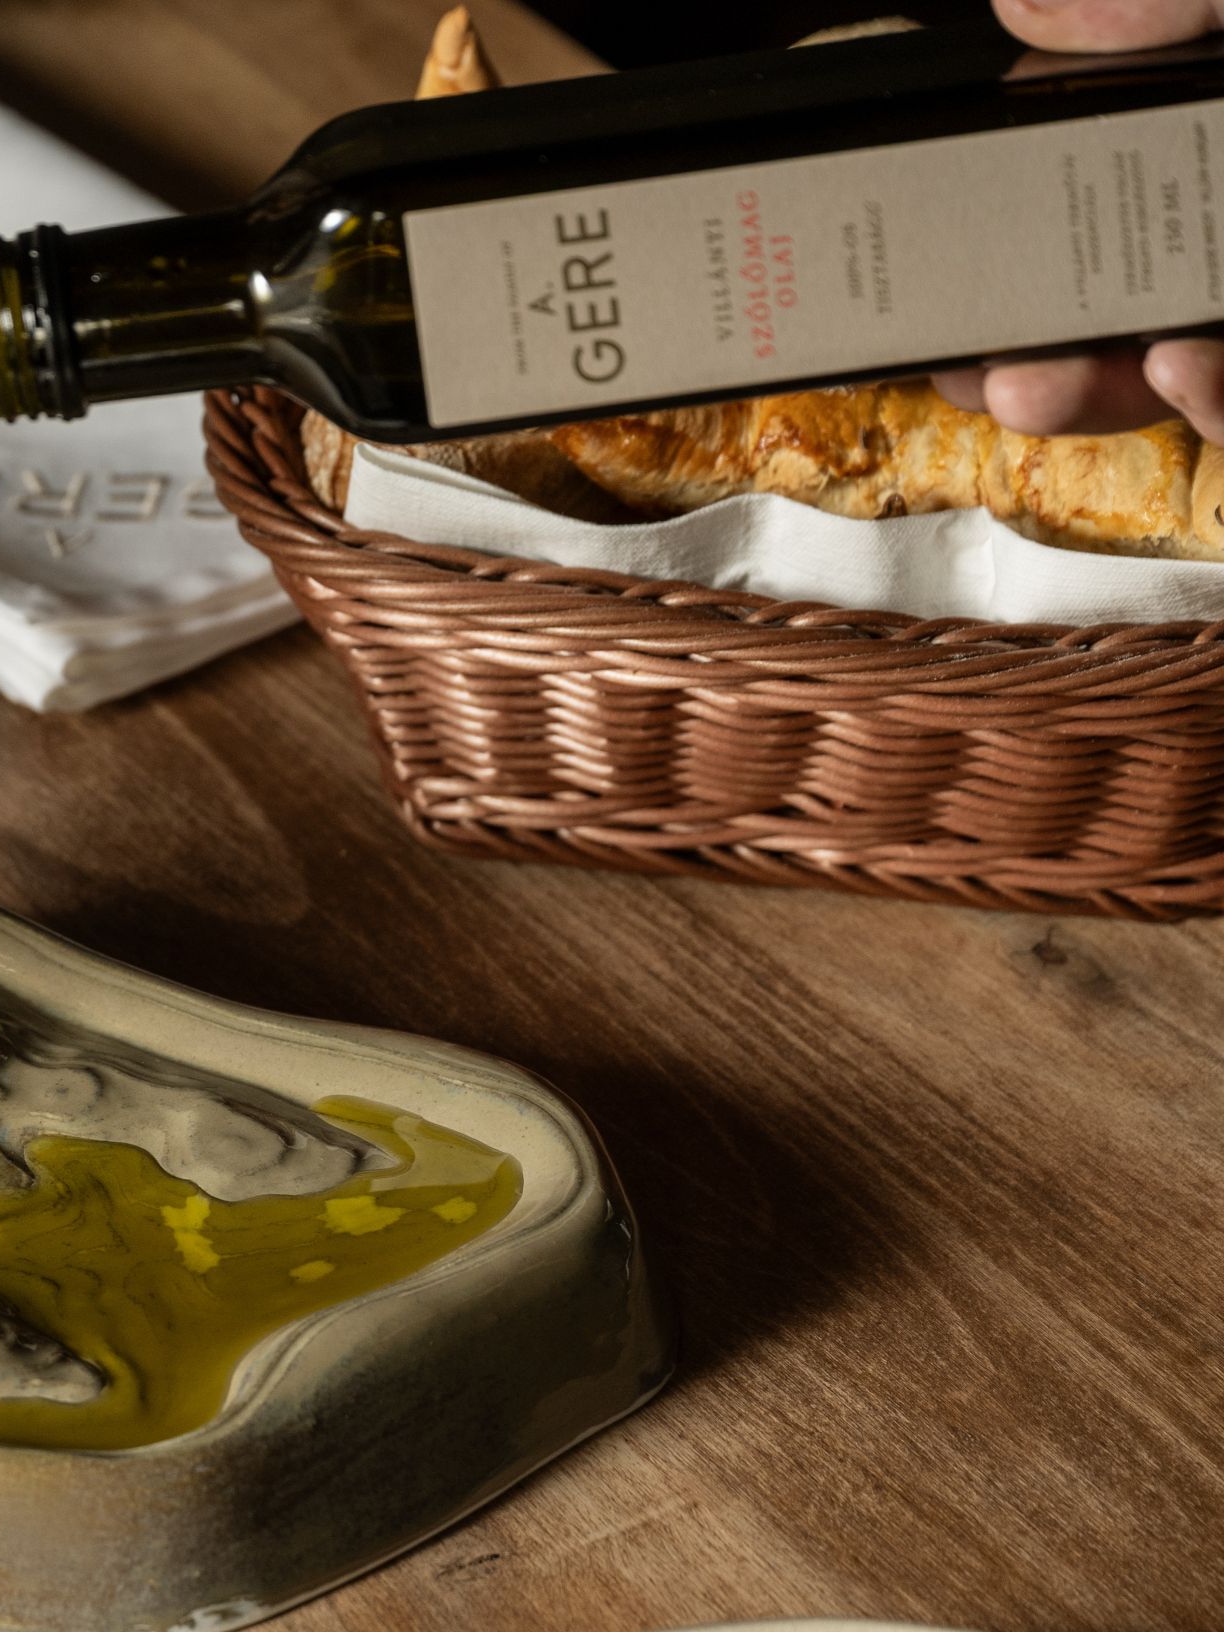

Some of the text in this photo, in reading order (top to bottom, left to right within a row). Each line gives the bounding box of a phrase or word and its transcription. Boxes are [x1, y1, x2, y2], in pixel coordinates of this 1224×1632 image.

[527, 281, 557, 317] A.
[555, 208, 626, 384] GERE
[703, 217, 734, 343] VILLÁNYI
[768, 235, 799, 309] OLAJ
